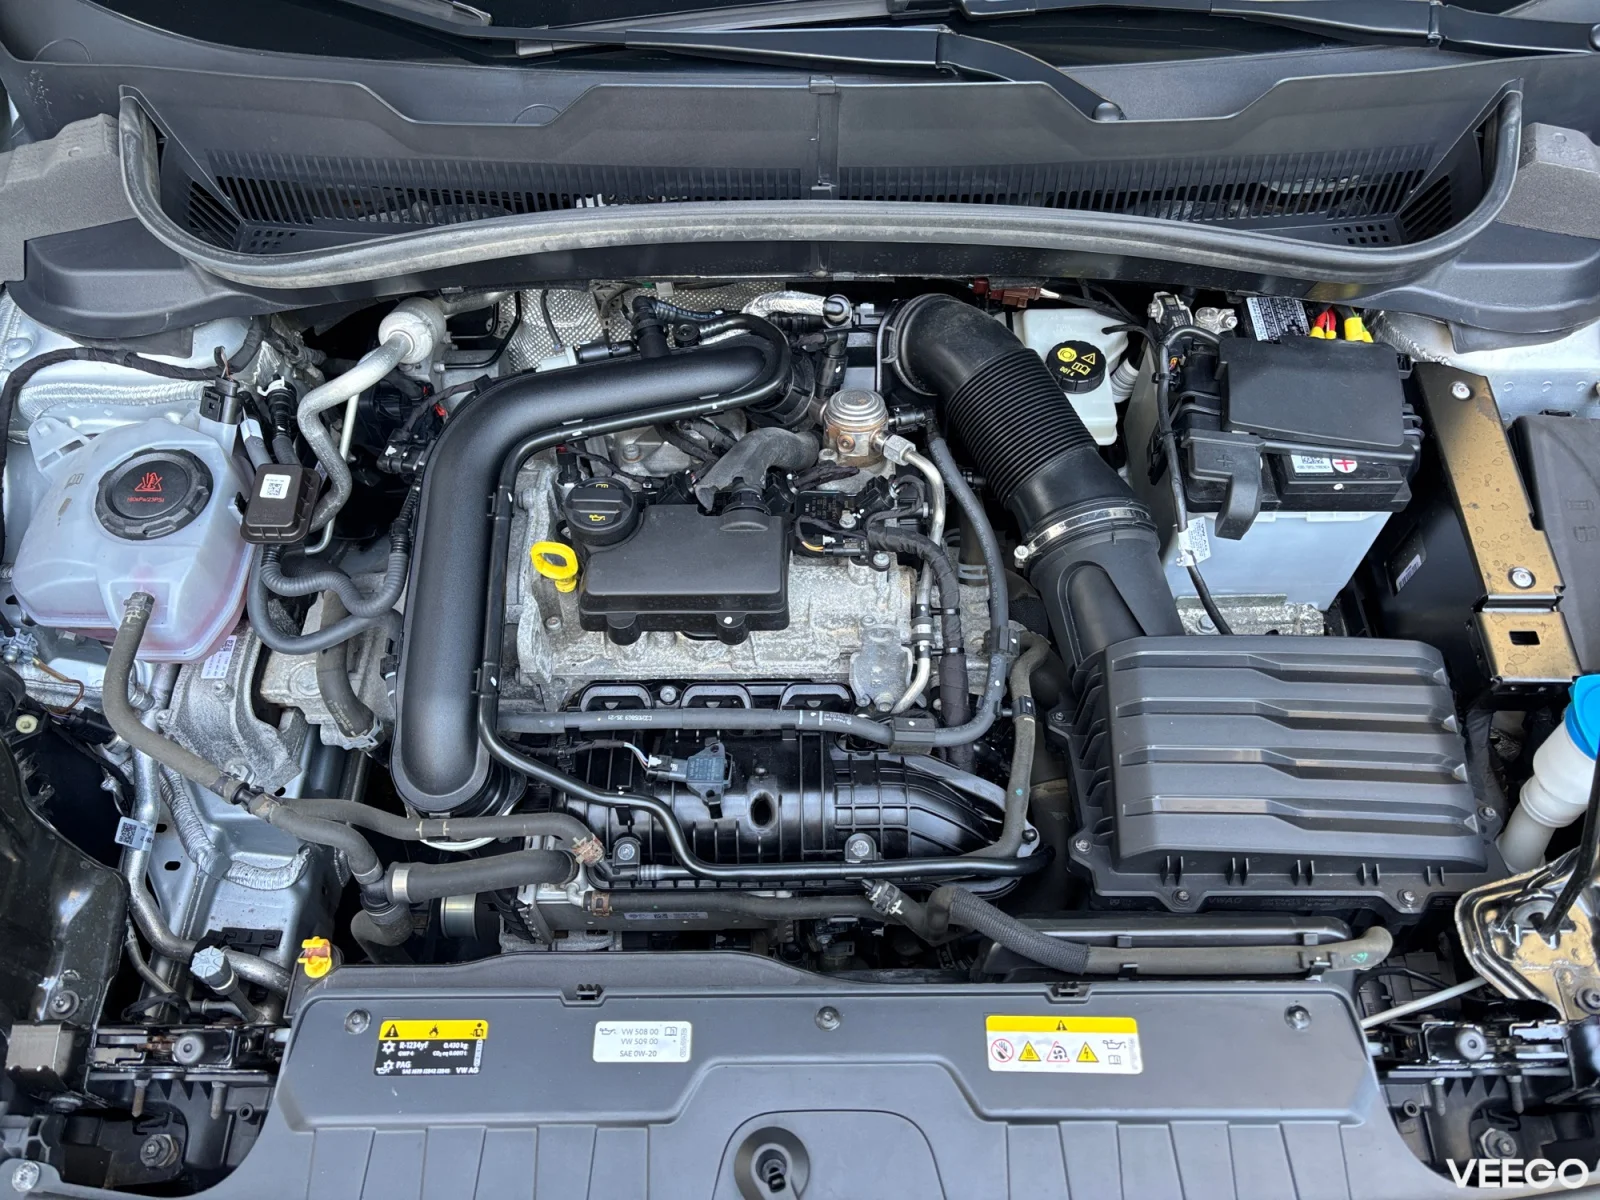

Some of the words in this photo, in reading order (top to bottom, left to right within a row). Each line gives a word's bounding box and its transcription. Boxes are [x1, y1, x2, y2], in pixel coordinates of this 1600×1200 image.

[621, 1028, 633, 1036] VW
[635, 1028, 648, 1036] 508
[649, 1028, 659, 1036] 00
[399, 1041, 429, 1051] R-1234yf
[459, 1042, 469, 1050] kg
